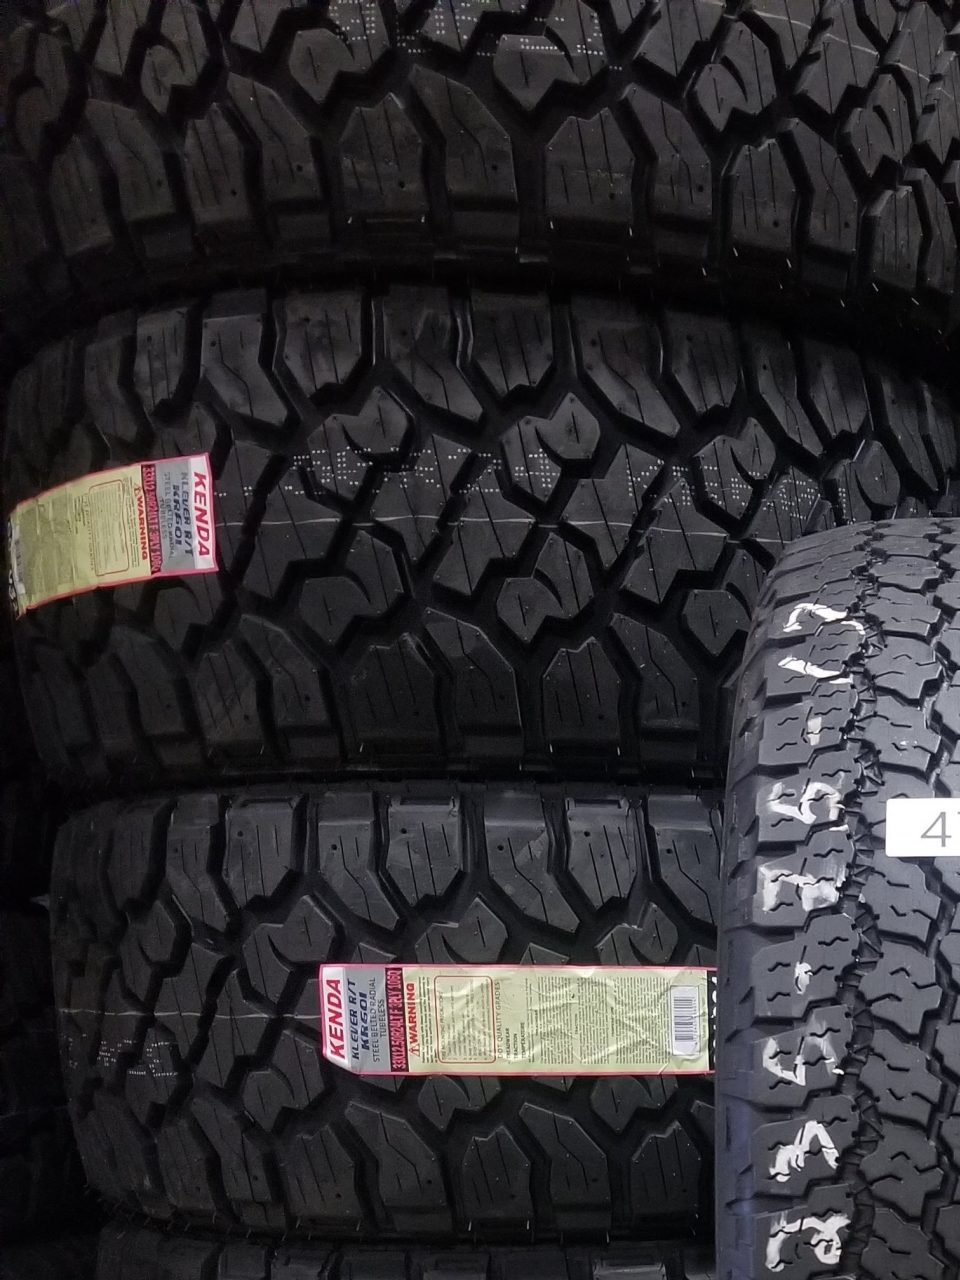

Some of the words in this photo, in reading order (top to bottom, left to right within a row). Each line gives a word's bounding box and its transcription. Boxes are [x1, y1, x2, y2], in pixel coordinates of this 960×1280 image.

[137, 496, 148, 560] WARNING
[194, 472, 210, 556] KENDA
[347, 978, 356, 1004] R/T
[406, 983, 417, 1044] WARNING
[326, 979, 345, 1059] KENDA
[349, 1010, 359, 1060] KLEVER
[370, 1008, 378, 1037] BELTED
[378, 999, 387, 1038] TUBELESS
[372, 1039, 380, 1062] STEEL
